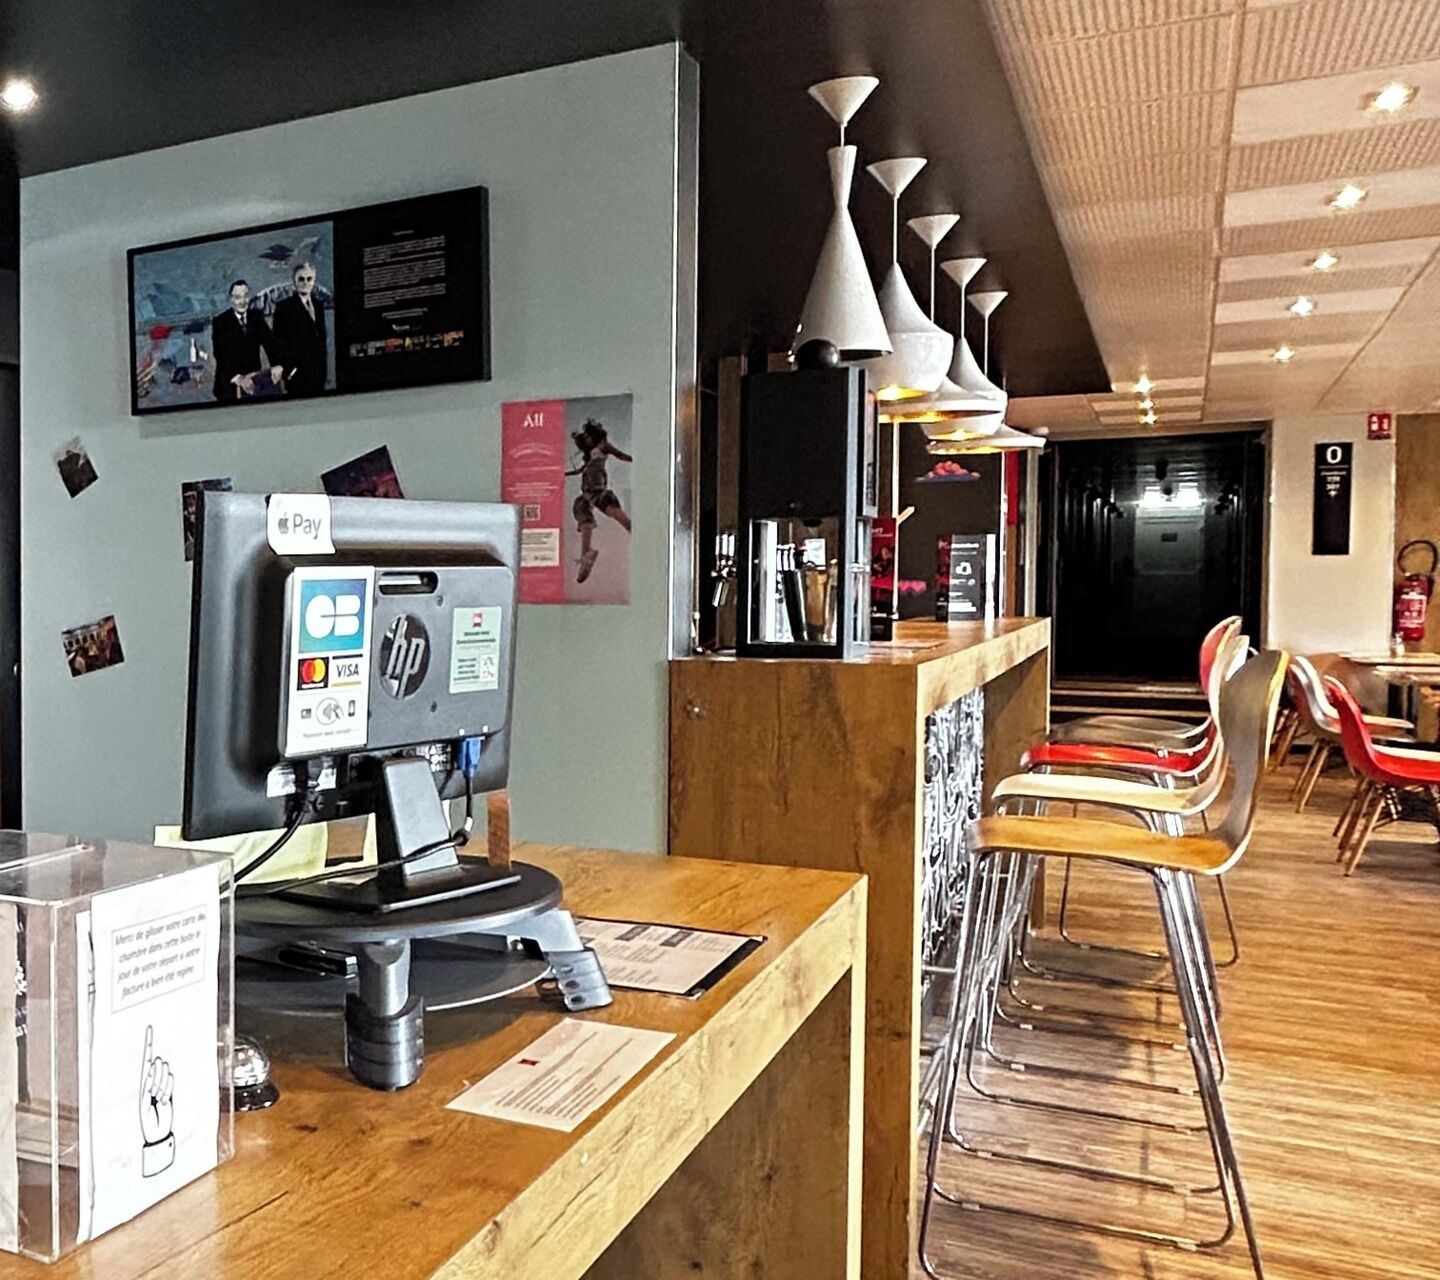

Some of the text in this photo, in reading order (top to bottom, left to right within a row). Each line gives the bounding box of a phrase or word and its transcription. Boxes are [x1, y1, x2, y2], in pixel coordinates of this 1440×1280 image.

[523, 412, 544, 428] All
[292, 513, 323, 540] Pay
[304, 593, 361, 640] CB
[336, 663, 360, 678] VISA
[386, 613, 426, 701] hp
[115, 915, 196, 946] Merci de glisser votre carte
[119, 947, 147, 964] chambre
[148, 941, 163, 955] dans
[164, 937, 179, 950] cette
[117, 947, 201, 985] jour votre départ votre
[121, 971, 175, 1001] facture bien été
